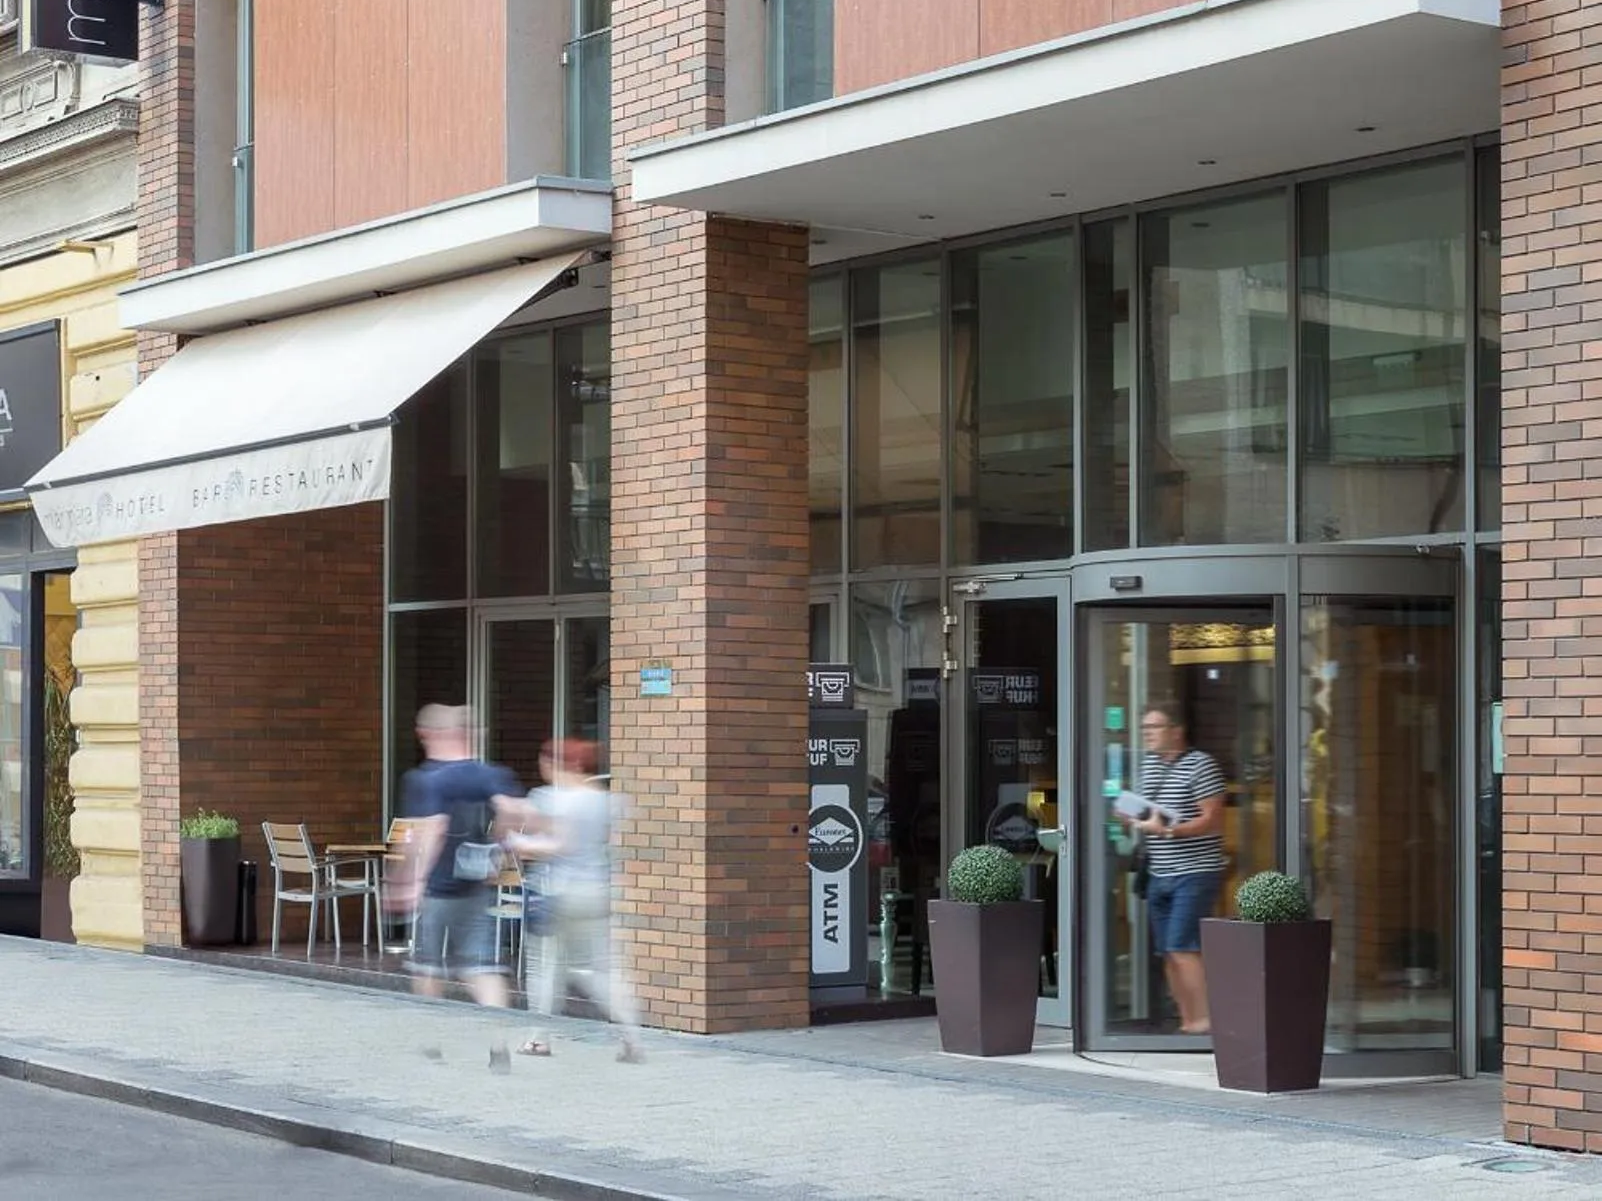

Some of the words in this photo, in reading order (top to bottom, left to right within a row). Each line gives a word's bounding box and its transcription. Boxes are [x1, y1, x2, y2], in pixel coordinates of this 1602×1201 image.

[249, 458, 373, 496] RESTAURANT
[115, 492, 166, 521] HOTEL
[806, 753, 828, 766] UF
[809, 739, 828, 752] UR
[823, 882, 839, 944] ATM
